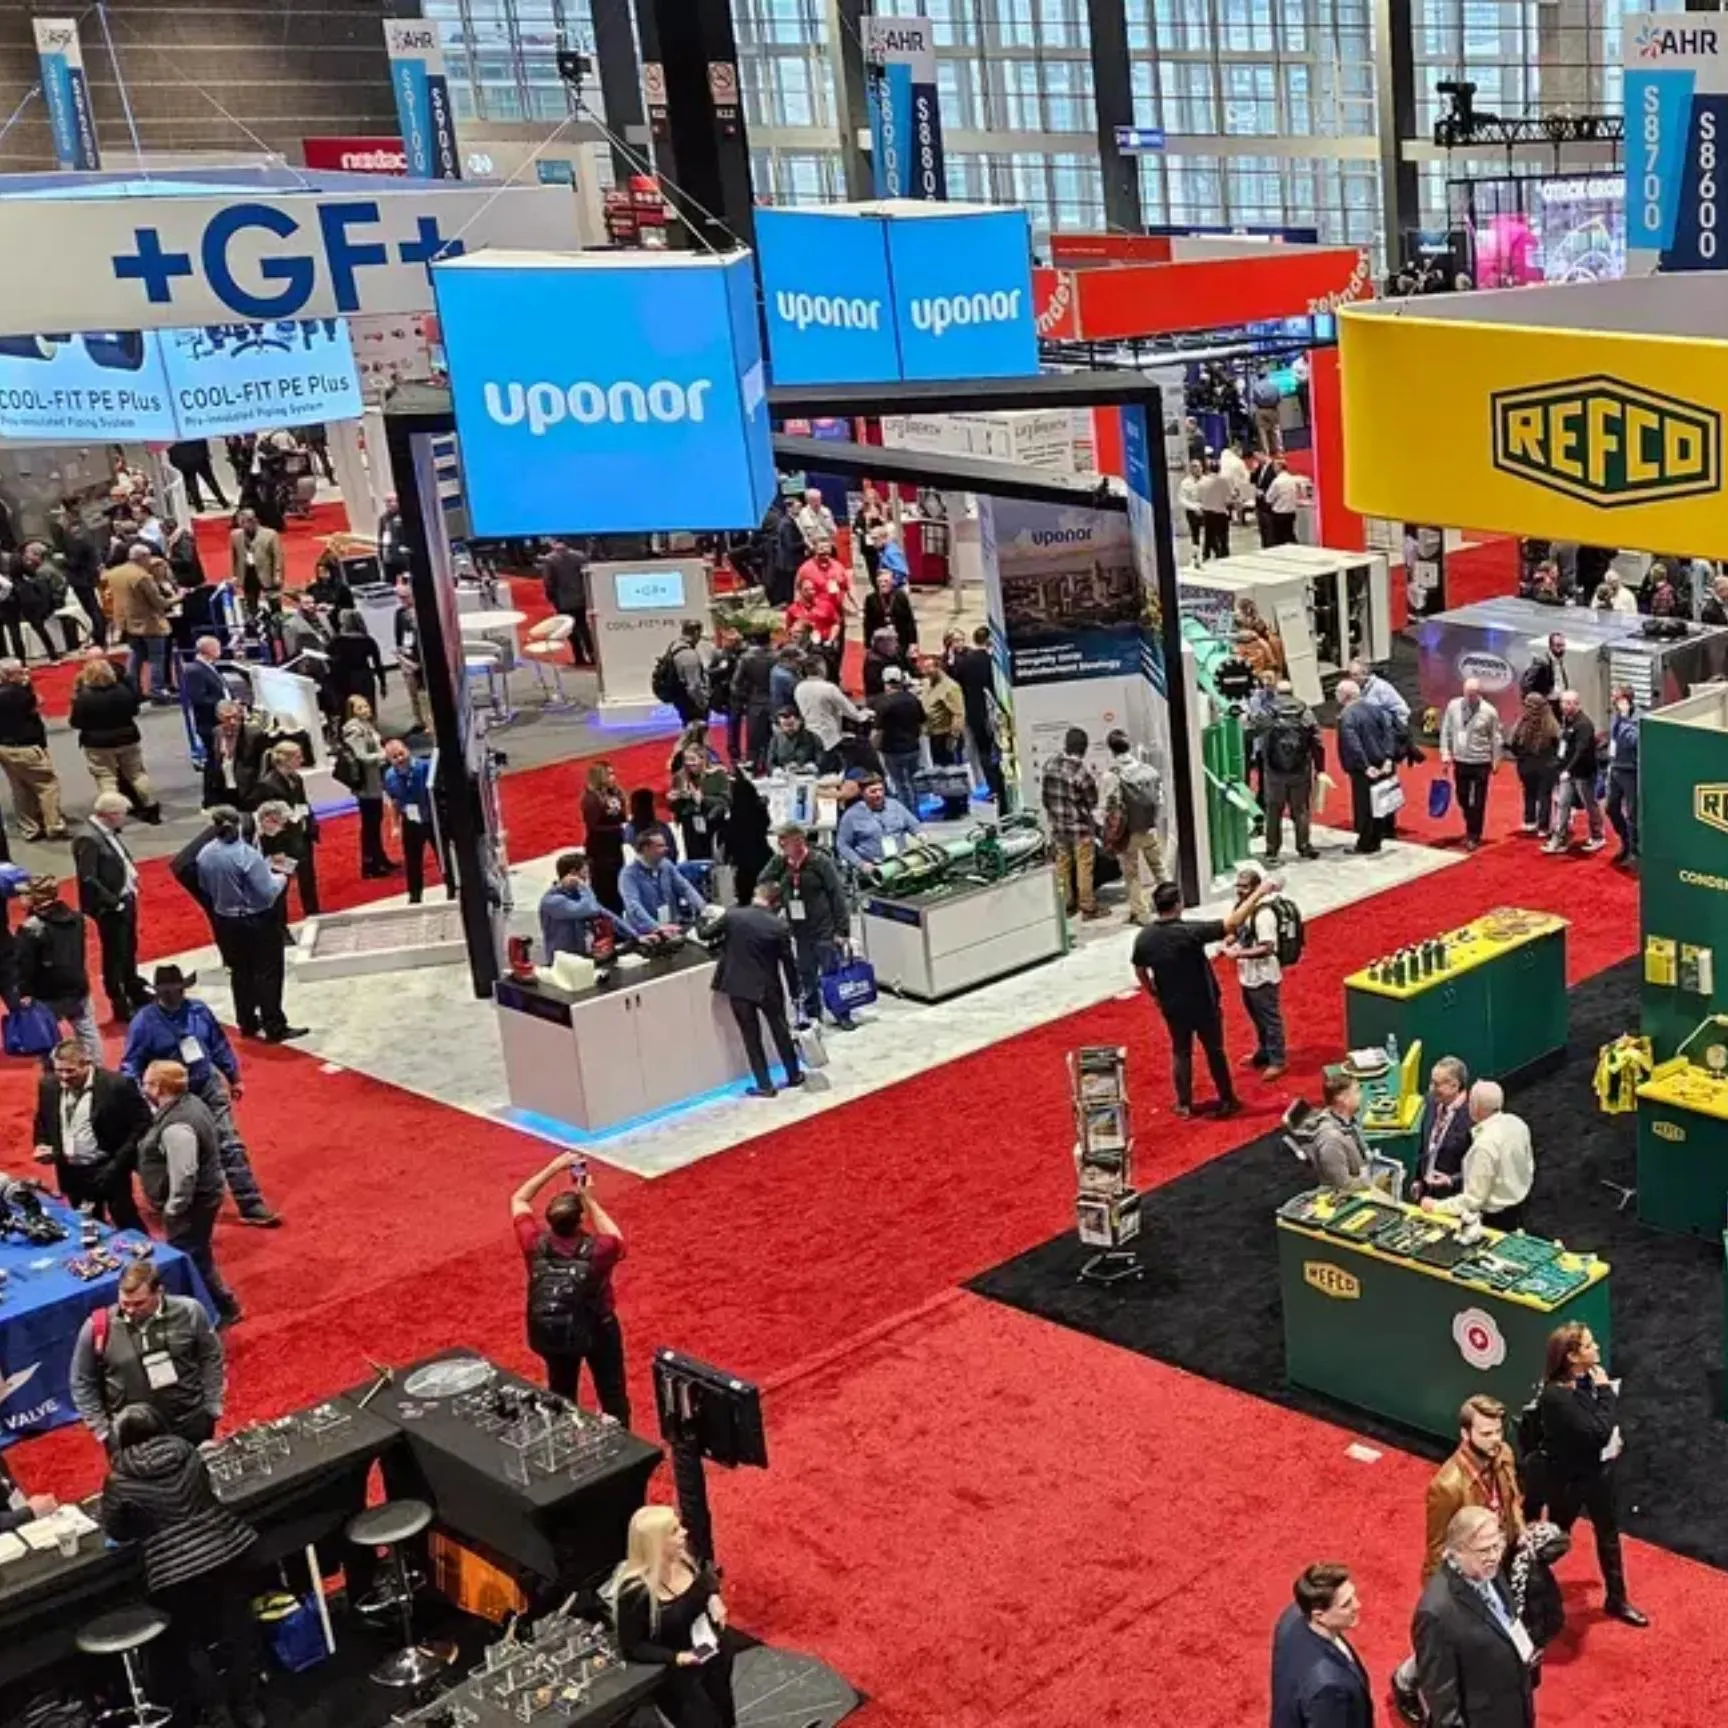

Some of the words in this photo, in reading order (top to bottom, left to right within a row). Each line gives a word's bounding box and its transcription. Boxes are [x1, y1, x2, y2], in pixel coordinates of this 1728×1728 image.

[886, 31, 925, 51] AHR
[1661, 29, 1718, 55] AHR
[880, 77, 899, 197] S8900
[916, 97, 937, 202] S880
[1644, 85, 1661, 232] S8700
[1699, 111, 1716, 259] S8600
[776, 290, 880, 332] uponor
[911, 288, 1021, 336] uponor
[90, 391, 112, 411] PE
[119, 390, 162, 412] Plus
[180, 382, 271, 410] COOL-FIT
[278, 379, 302, 400] PE
[309, 375, 350, 393] Plus
[483, 378, 712, 436] uponor
[1506, 397, 1704, 488] REFCO
[1031, 528, 1093, 546] uponor
[4, 1397, 59, 1430] VALVE
